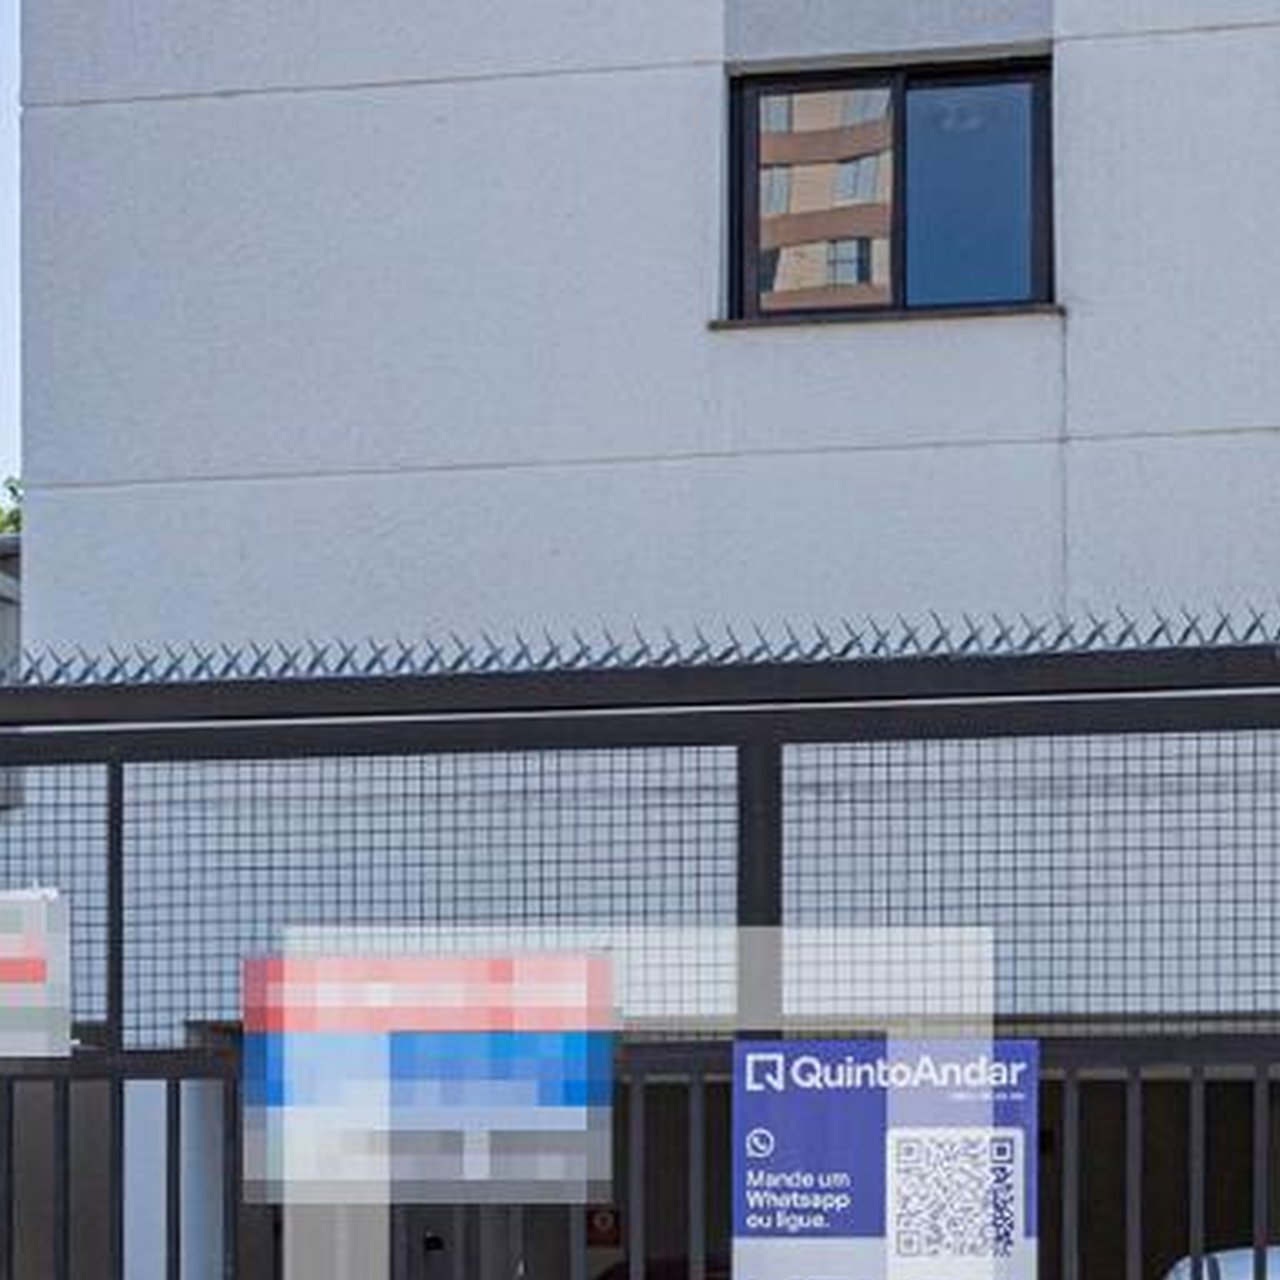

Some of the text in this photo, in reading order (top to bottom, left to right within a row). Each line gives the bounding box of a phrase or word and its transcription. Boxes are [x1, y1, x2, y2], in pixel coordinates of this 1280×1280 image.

[792, 1055, 1027, 1088] QuintoAndar
[746, 1170, 851, 1188] Mande um
[746, 1214, 772, 1228] ou
